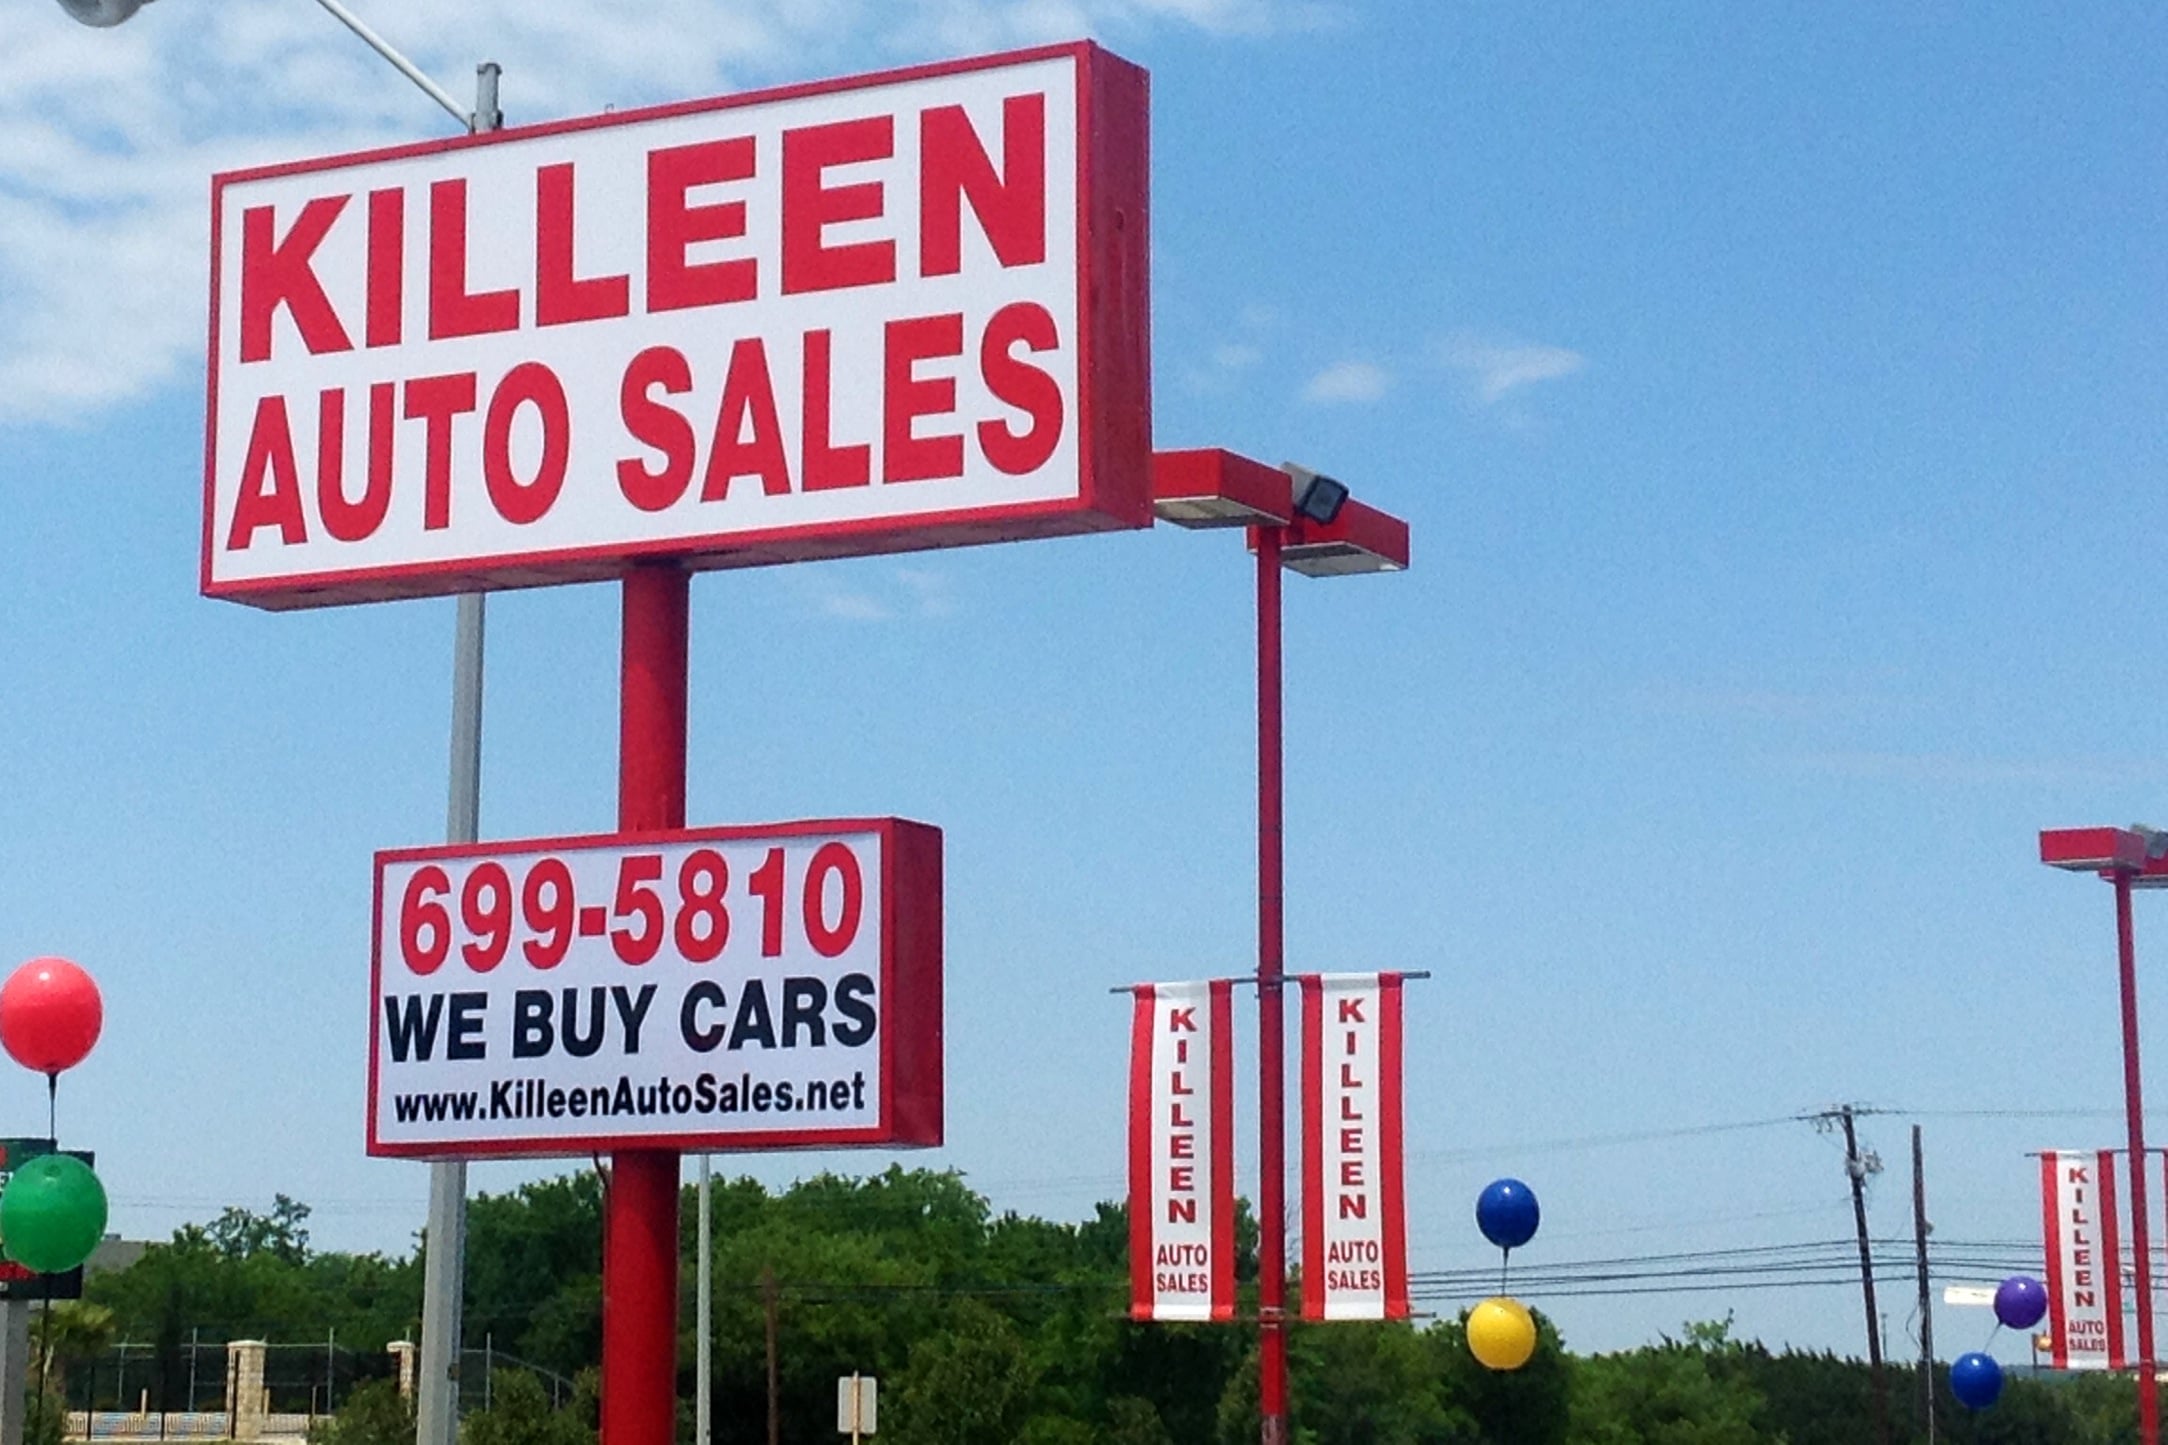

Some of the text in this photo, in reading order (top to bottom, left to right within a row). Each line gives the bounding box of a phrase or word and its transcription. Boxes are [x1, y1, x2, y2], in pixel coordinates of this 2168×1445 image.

[240, 92, 1046, 364] KILLEEN
[226, 301, 1064, 551] AUTO SALES
[399, 841, 863, 976] 699-5810
[384, 972, 878, 1063] WE BUY CARS
[395, 1070, 866, 1123] www.KilleenAutoSales.net
[1168, 1006, 1197, 1224] KILLEEN
[1338, 997, 1367, 1220] KILLEEN
[1156, 1243, 1208, 1267] AUTO
[1328, 1240, 1379, 1264] AUTO
[2068, 1166, 2095, 1308] KILLEEN
[1156, 1272, 1209, 1294] SALES
[1328, 1269, 1381, 1291] SALES
[2068, 1320, 2105, 1336] AUTO
[2069, 1338, 2106, 1352] SALES
